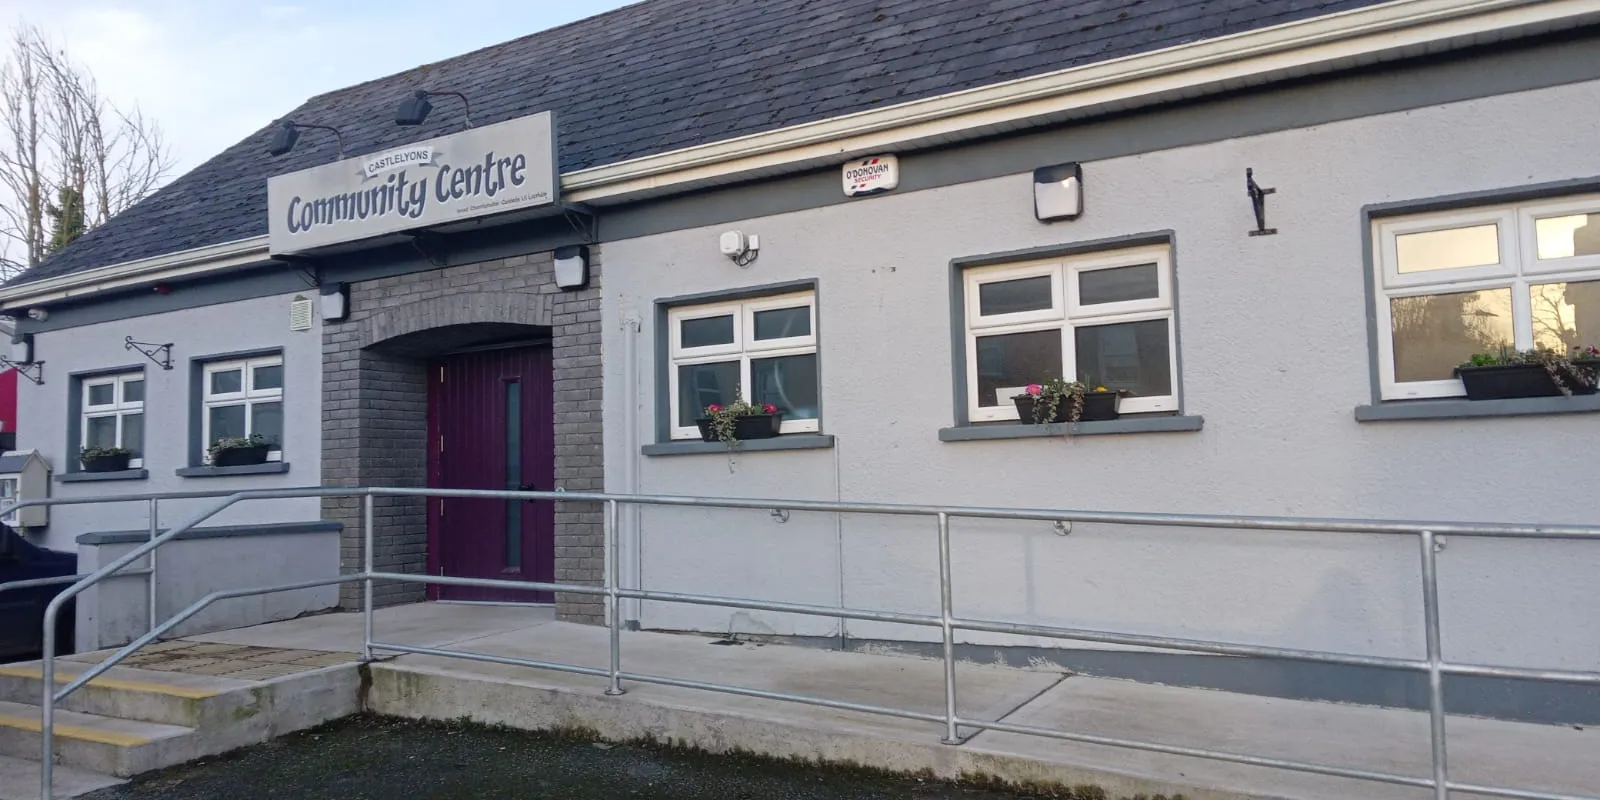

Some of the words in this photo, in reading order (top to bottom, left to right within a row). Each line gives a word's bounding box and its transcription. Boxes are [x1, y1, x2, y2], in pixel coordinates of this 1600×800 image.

[368, 150, 428, 173] CASTLELYONS
[846, 163, 889, 179] O'DONOVAN
[854, 174, 881, 183] SECURITY
[287, 170, 427, 233] Community
[435, 151, 526, 203] Centre
